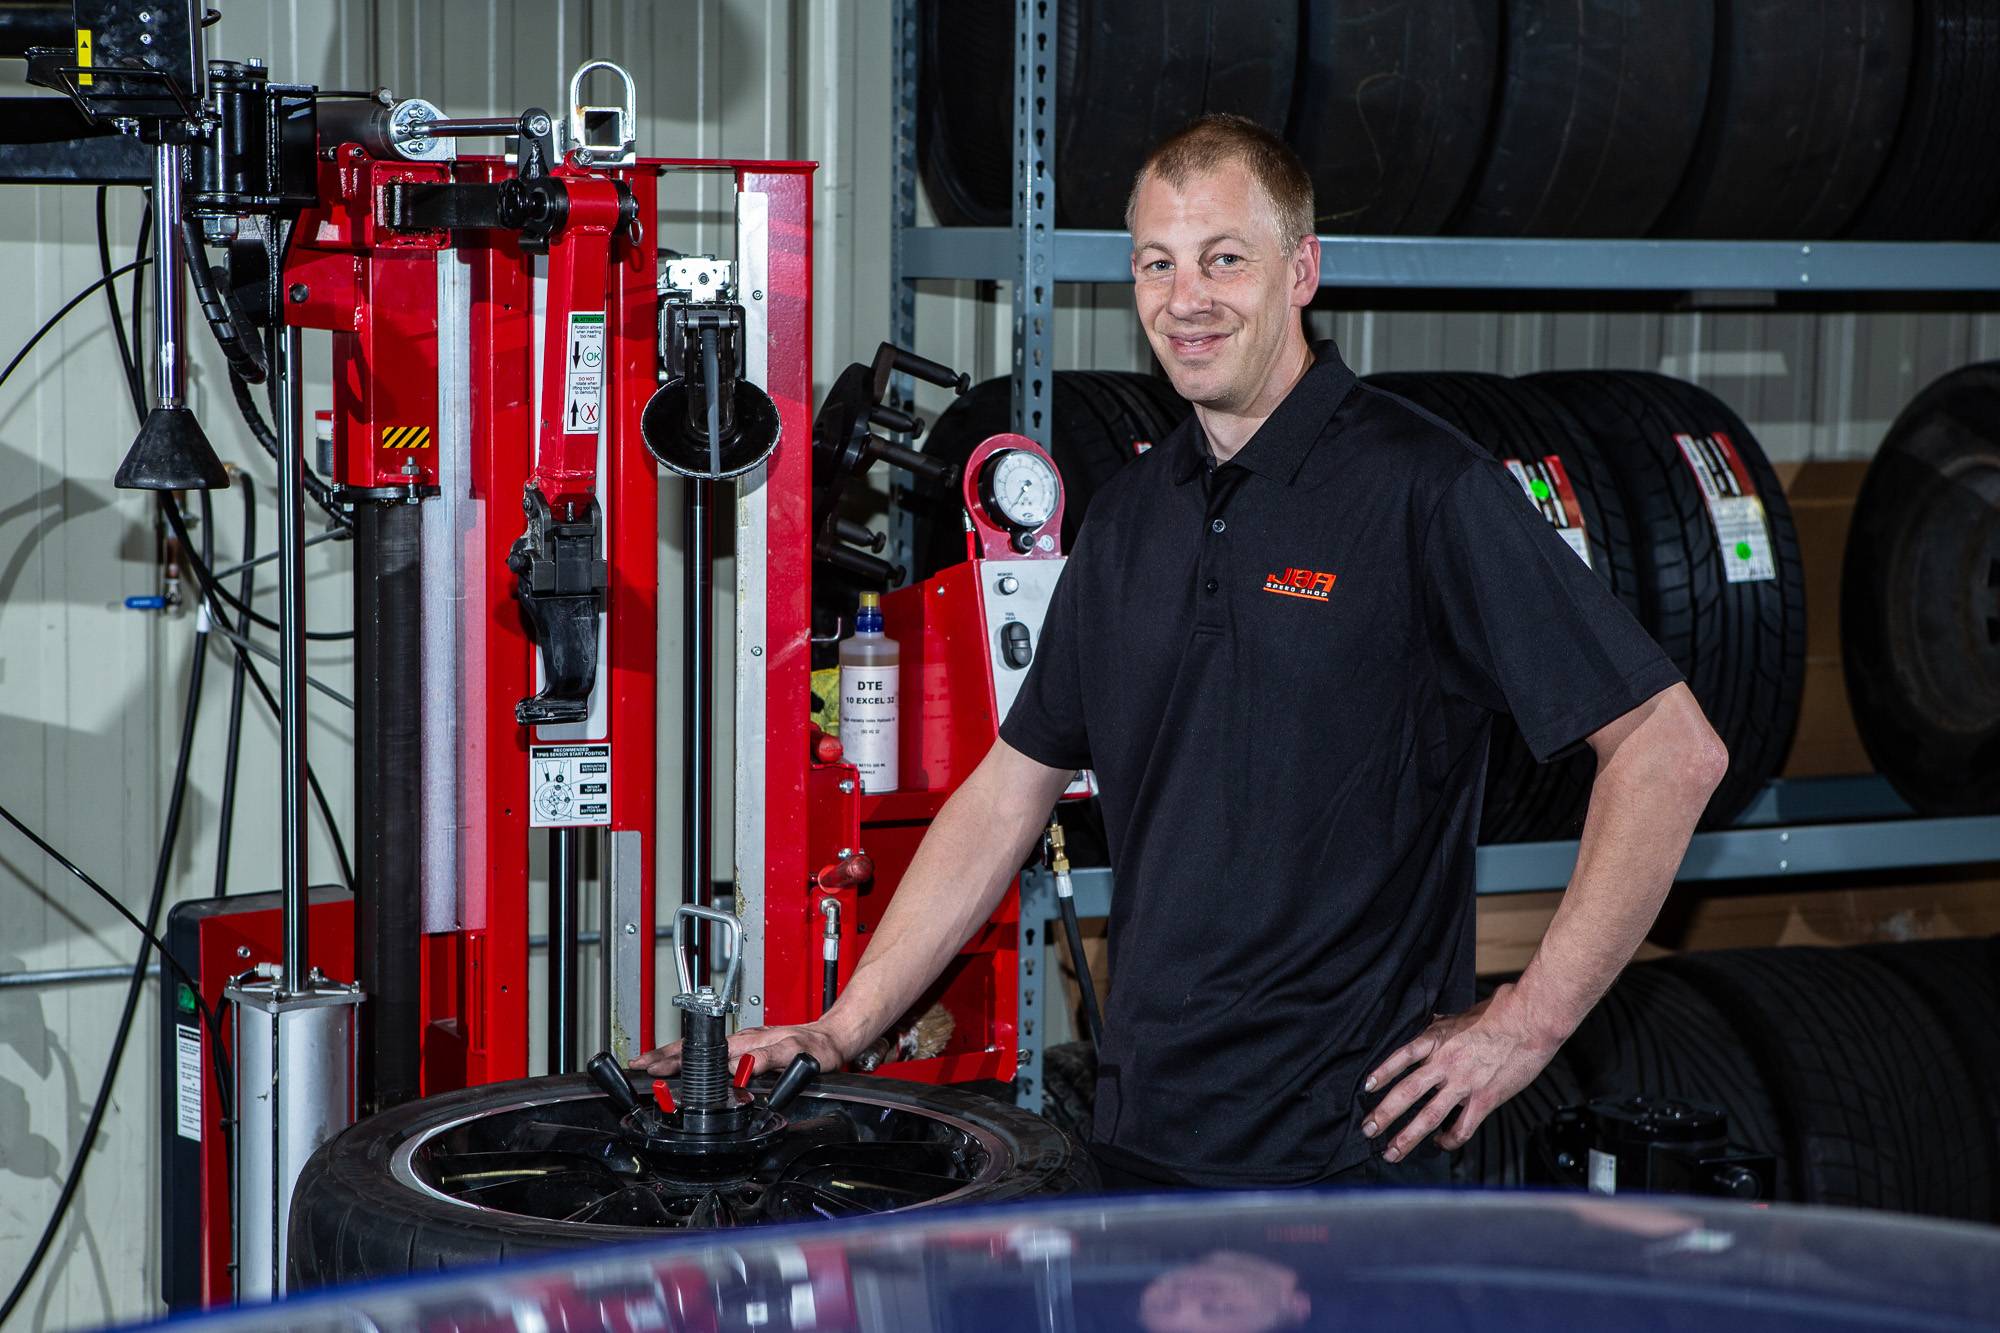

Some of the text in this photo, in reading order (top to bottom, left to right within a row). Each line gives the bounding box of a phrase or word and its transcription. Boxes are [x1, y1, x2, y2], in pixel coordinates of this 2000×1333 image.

[586, 352, 600, 361] OK
[1266, 567, 1336, 592] JBA
[1266, 582, 1328, 597] SPEED SHOP
[858, 681, 883, 691] DTE
